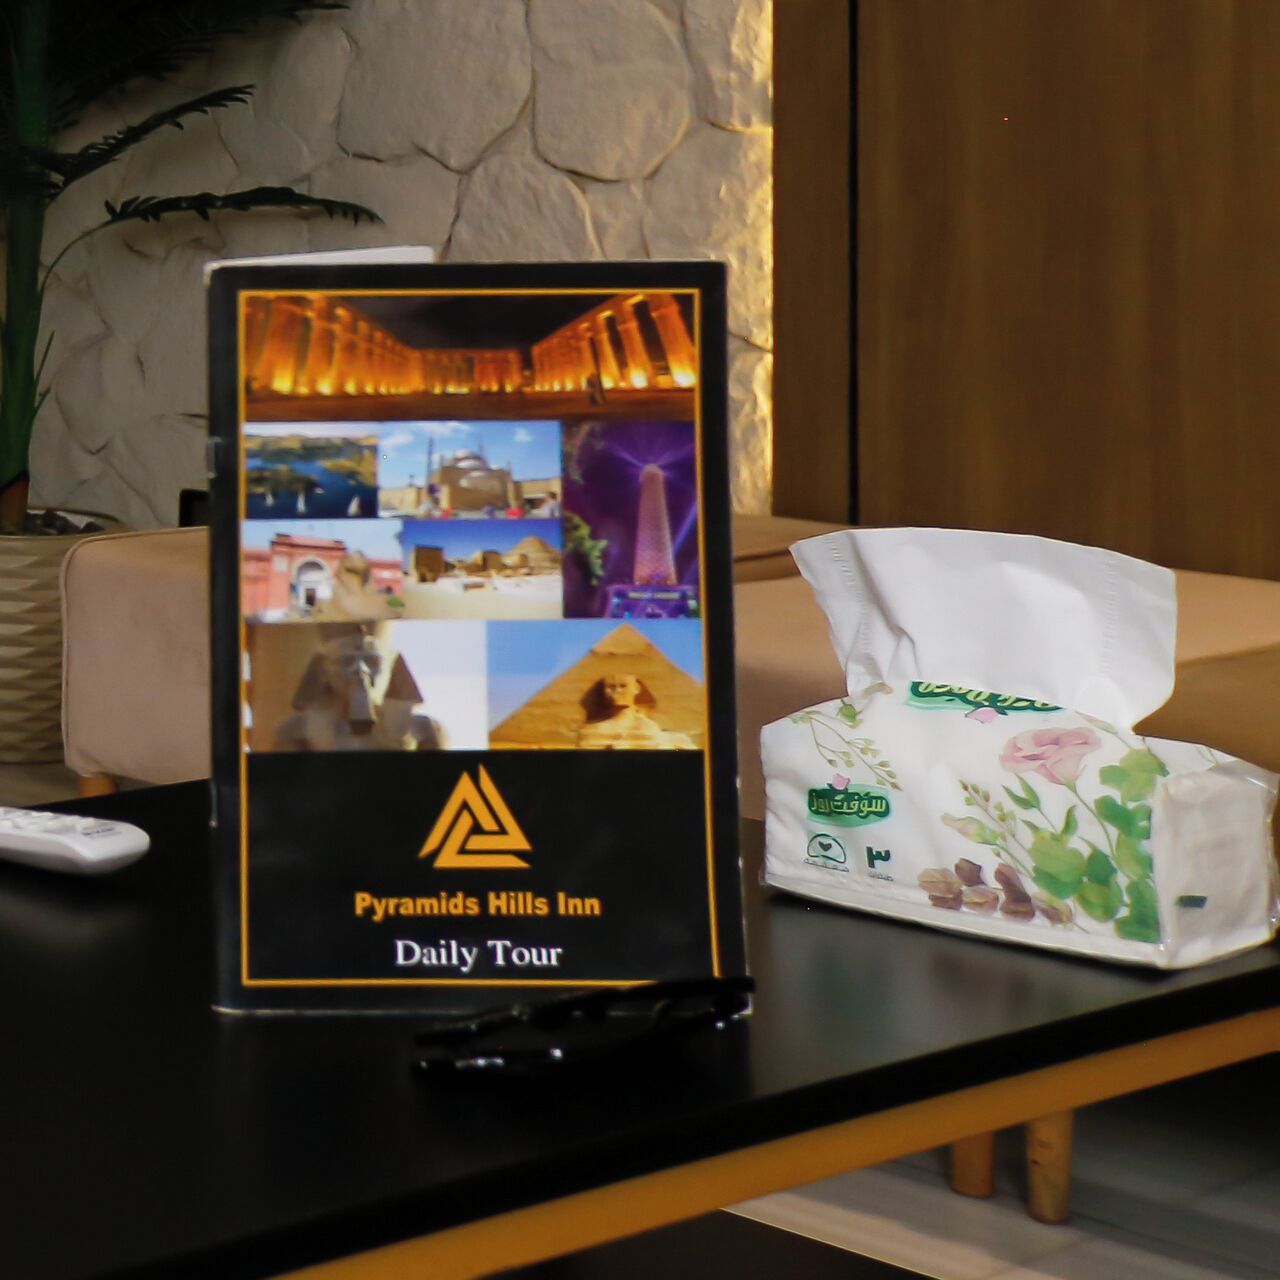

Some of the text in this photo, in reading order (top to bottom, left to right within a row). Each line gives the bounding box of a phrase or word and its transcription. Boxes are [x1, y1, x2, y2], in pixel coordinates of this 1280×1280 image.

[354, 891, 602, 922] Pyramids Hills Inn
[394, 939, 563, 973] Daily Tour
